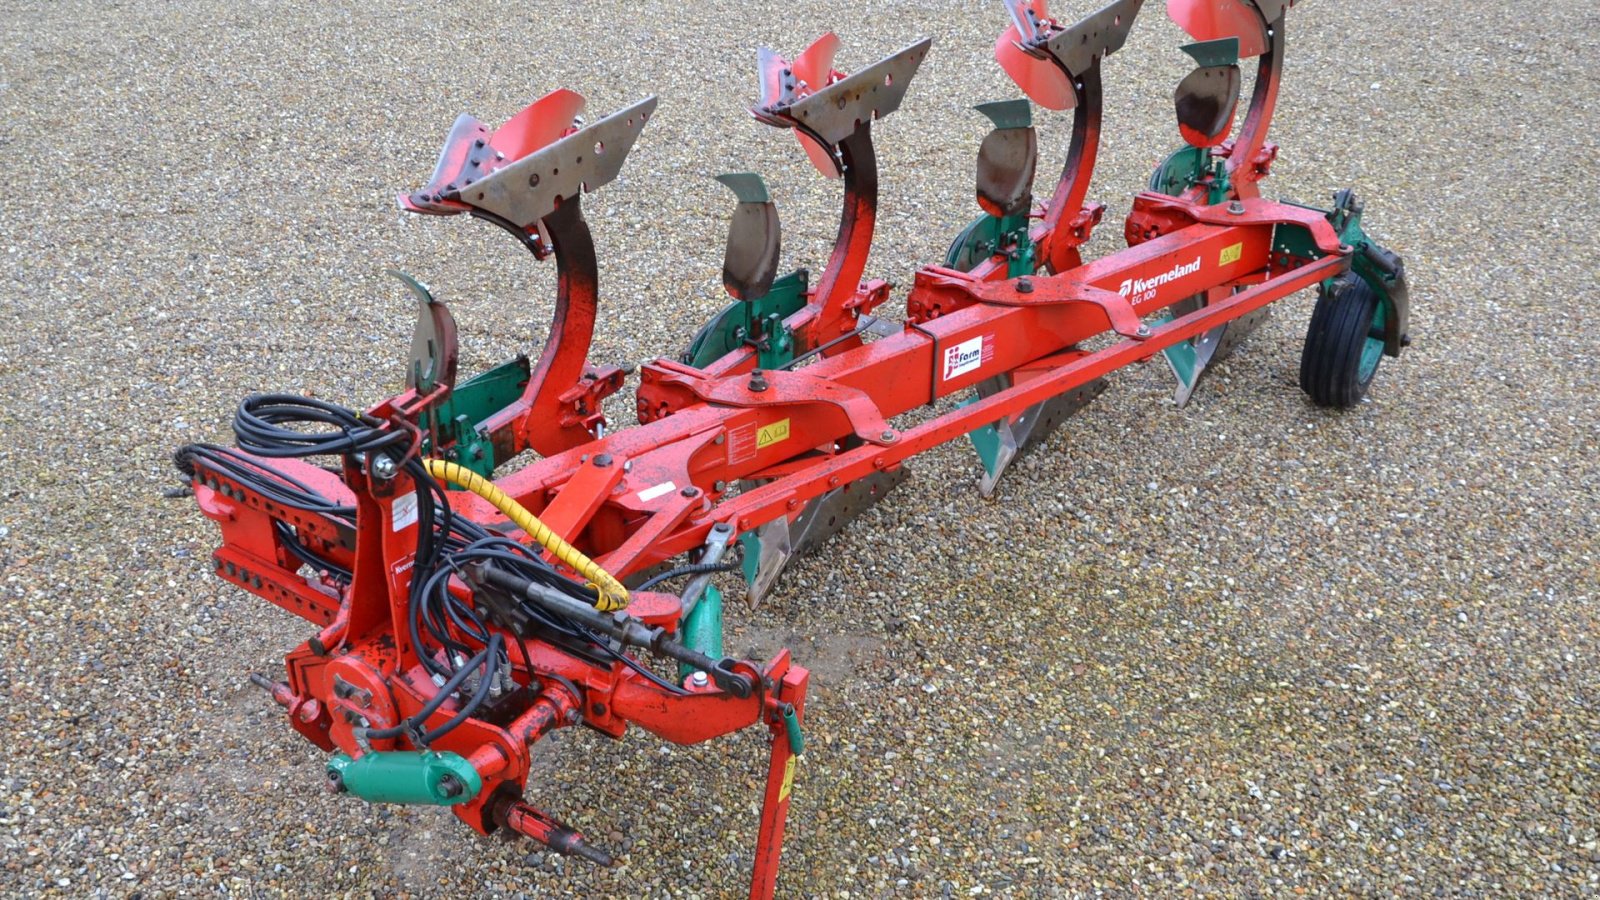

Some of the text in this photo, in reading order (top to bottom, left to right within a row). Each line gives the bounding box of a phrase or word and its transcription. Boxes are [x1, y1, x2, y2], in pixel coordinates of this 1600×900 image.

[1132, 255, 1201, 296] Kverneland
[1131, 288, 1157, 306] EG 100
